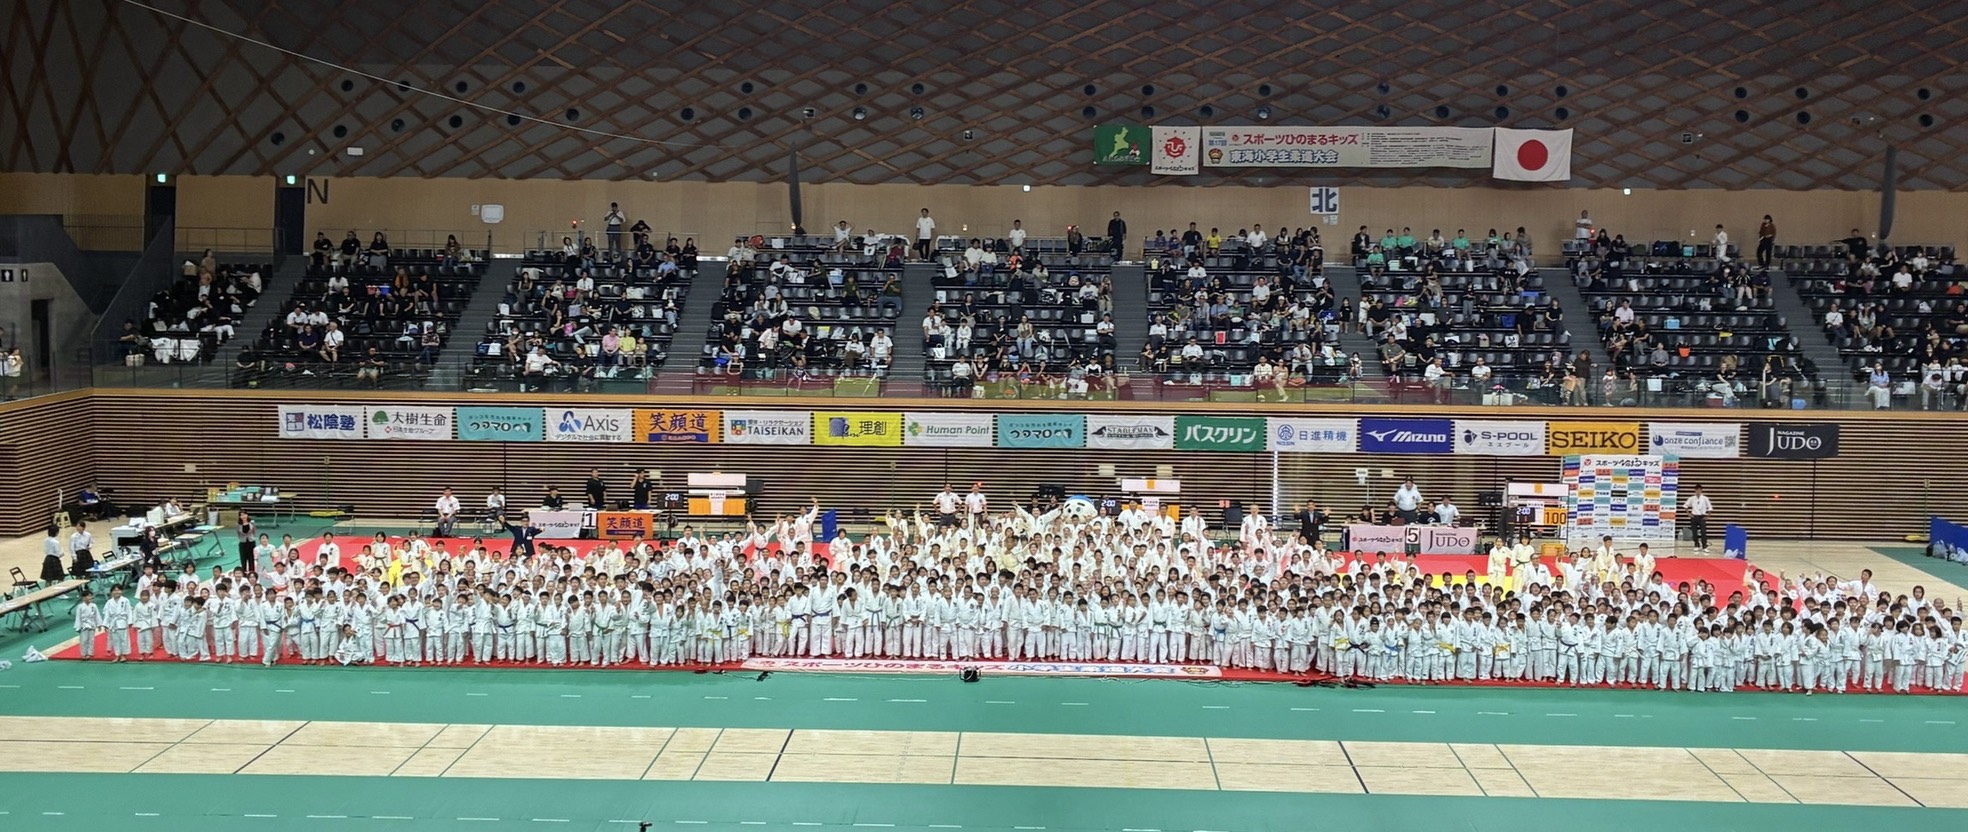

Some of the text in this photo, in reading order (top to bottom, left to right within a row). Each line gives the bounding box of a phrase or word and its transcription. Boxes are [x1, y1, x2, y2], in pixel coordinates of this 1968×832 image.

[1243, 134, 1359, 145] スポーツひのまるキッズ
[1230, 149, 1338, 164] 東海小学生柔道大会
[307, 179, 328, 204] N
[1312, 188, 1337, 212] 北
[308, 413, 355, 431] 松陰塾
[391, 412, 447, 427] 大樹生命
[583, 415, 619, 432] Axis
[649, 413, 708, 432] 笑顔道
[859, 421, 887, 435] 理創
[926, 425, 990, 434] Human Point
[1184, 425, 1256, 444] バスクリン
[1299, 430, 1347, 442] 日進精機
[1481, 431, 1538, 441] S-POOL
[1552, 431, 1636, 449] SEIKO
[1664, 436, 1724, 446] onze confiance
[1766, 427, 1822, 456] JUDO
[585, 513, 596, 528] 1
[607, 516, 645, 529] 笑顔道
[1407, 528, 1418, 542] 5
[1427, 530, 1470, 551] JUDO
